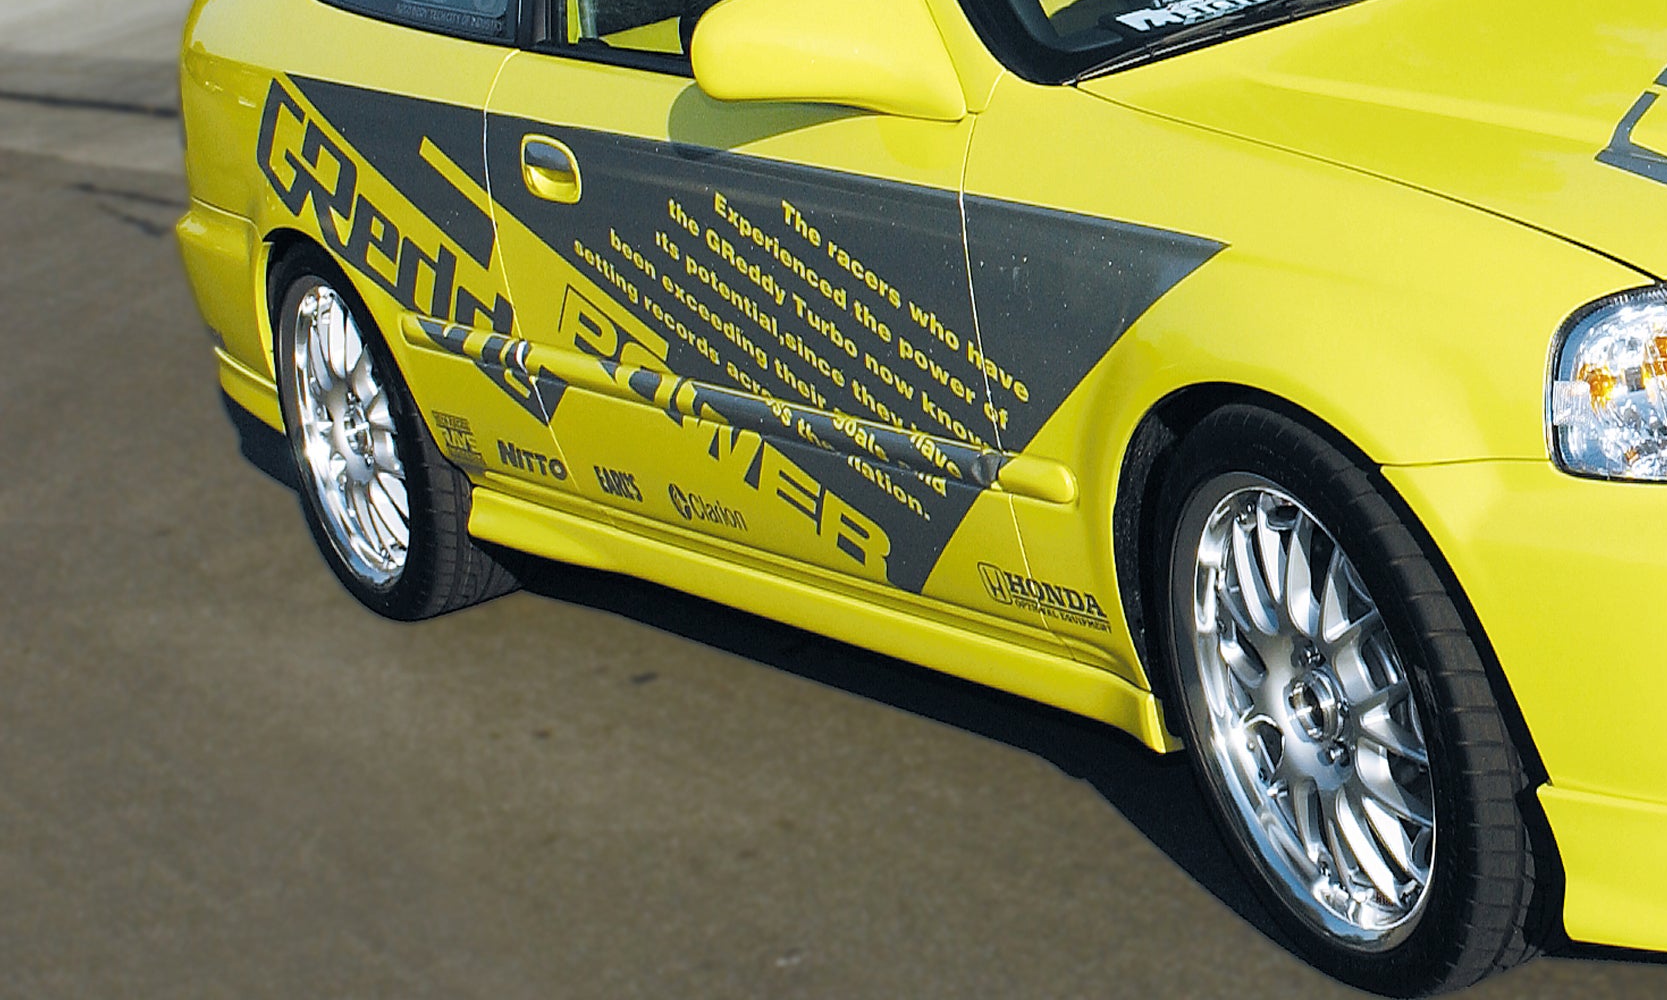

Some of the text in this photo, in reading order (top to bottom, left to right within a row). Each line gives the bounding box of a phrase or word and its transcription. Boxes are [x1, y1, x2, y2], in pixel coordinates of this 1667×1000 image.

[610, 226, 656, 280] been
[662, 274, 768, 370] exceeding
[774, 357, 827, 409] their
[655, 230, 680, 261] its
[668, 198, 700, 237] the
[706, 228, 786, 306] GReddy
[792, 292, 858, 358] Turbo
[864, 352, 914, 400] now
[714, 191, 1009, 431] Experienced the power of
[781, 199, 1030, 402] The racers who have
[497, 439, 568, 481] NITTO
[574, 239, 638, 304] setting
[644, 295, 721, 365] records
[847, 455, 931, 521] nation.
[689, 492, 748, 532] Clarion
[1004, 572, 1108, 618] HONDA
